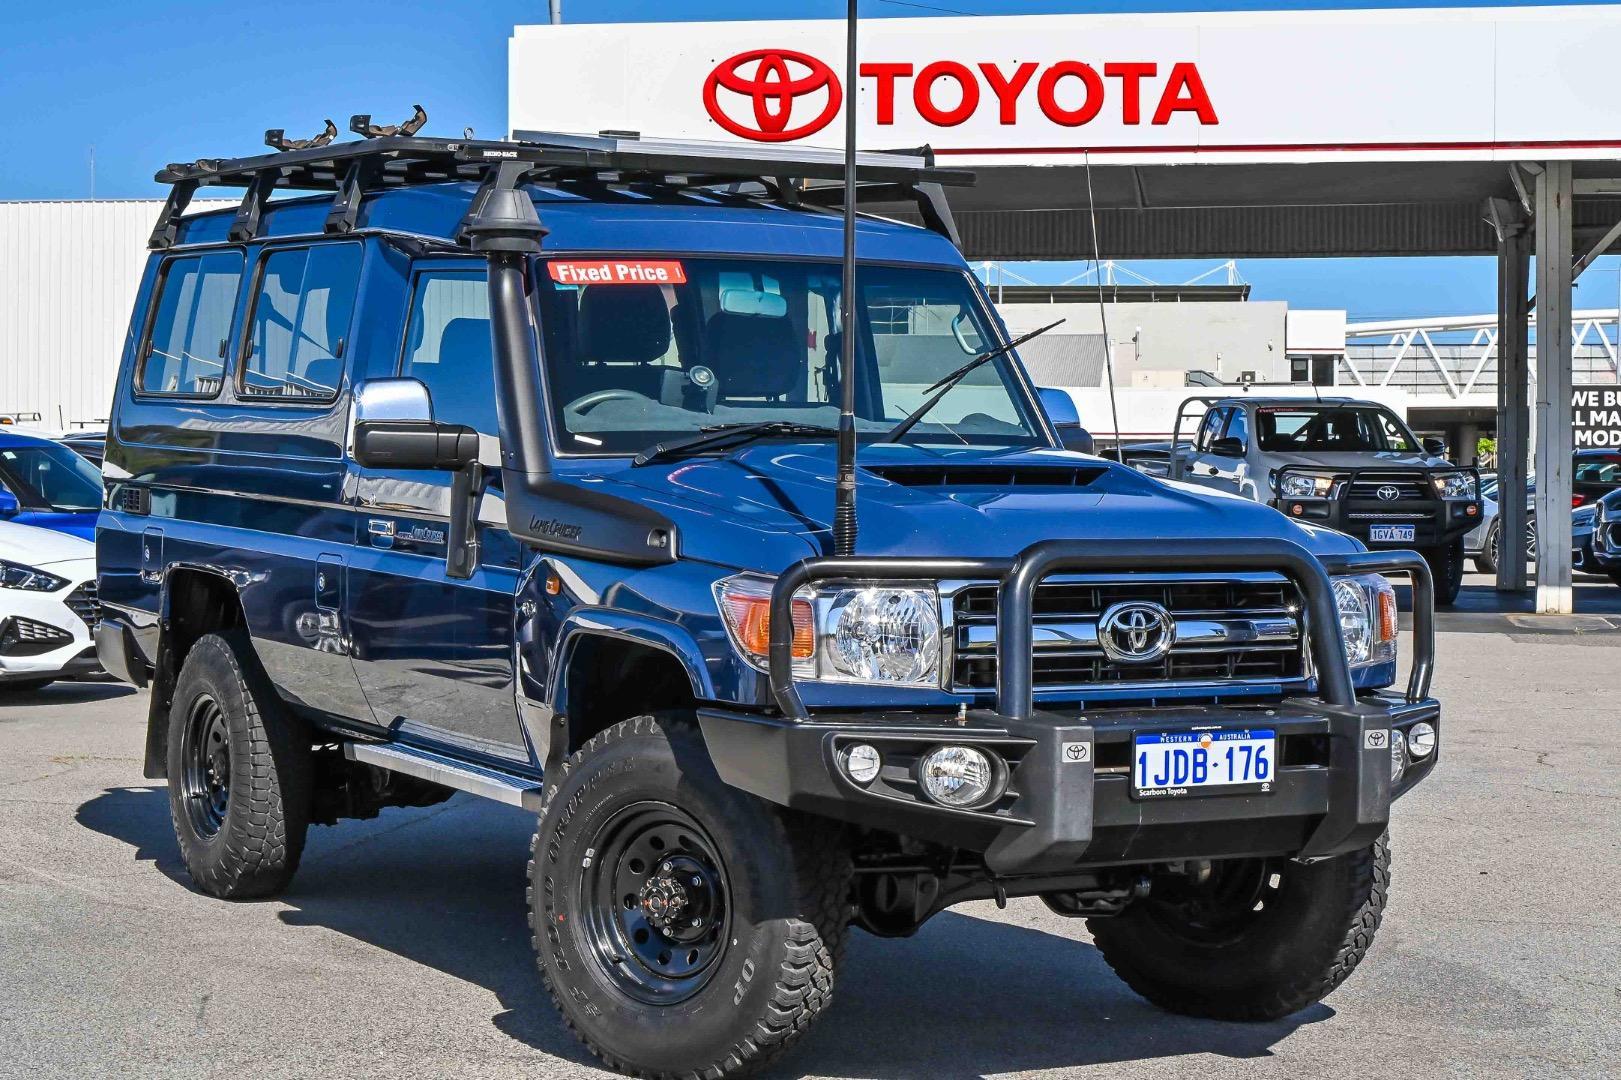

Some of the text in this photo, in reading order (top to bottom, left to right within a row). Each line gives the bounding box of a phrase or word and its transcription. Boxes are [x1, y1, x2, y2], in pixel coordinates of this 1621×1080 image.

[859, 60, 1219, 127] TOYOTA
[556, 264, 669, 282] Fixed Price
[1571, 391, 1599, 407] WE
[1571, 410, 1621, 426] L MA
[1574, 429, 1621, 446] MOD
[1160, 732, 1251, 744] WESTERN AUSTRALIA
[1139, 787, 1188, 797] Scarboro Toyota
